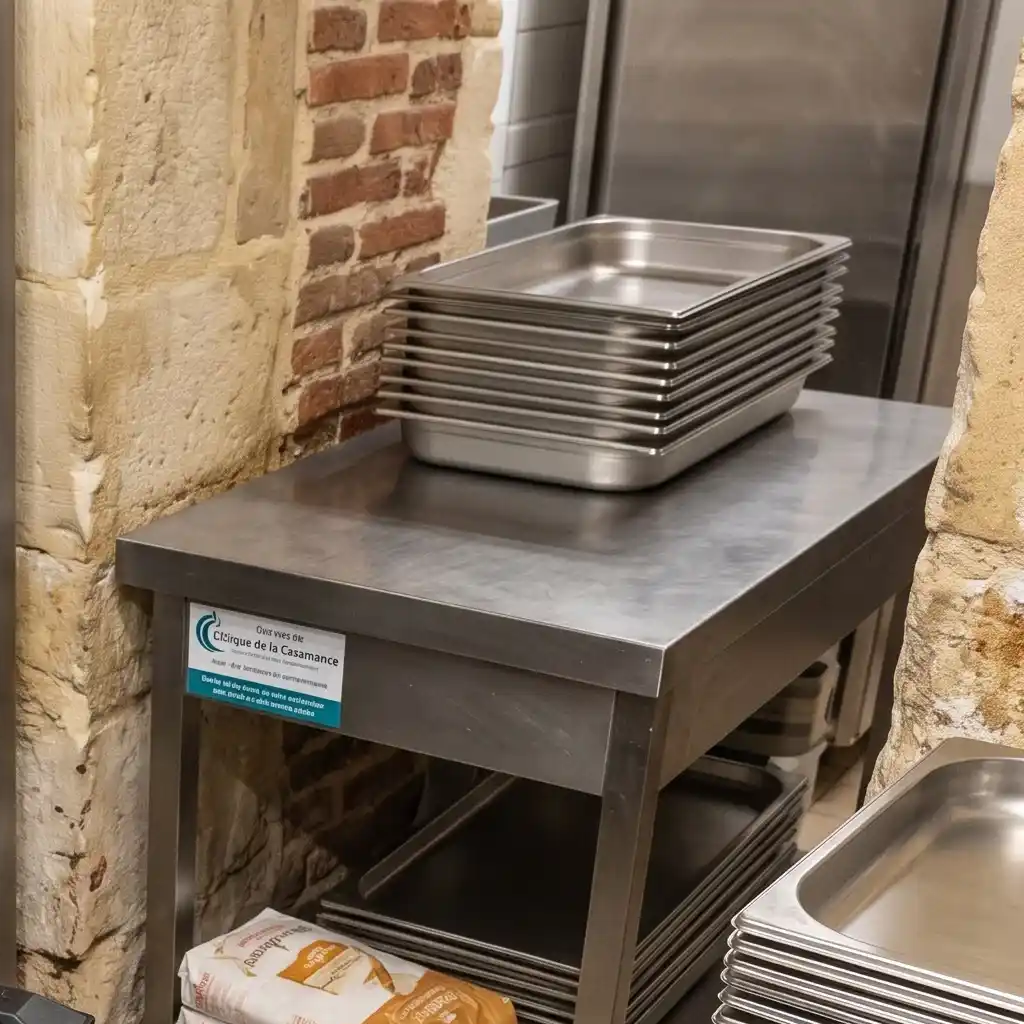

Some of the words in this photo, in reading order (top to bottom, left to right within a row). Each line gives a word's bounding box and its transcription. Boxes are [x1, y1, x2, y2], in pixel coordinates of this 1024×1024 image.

[254, 639, 267, 651] de
[269, 641, 278, 653] la
[280, 645, 339, 667] Casamance
